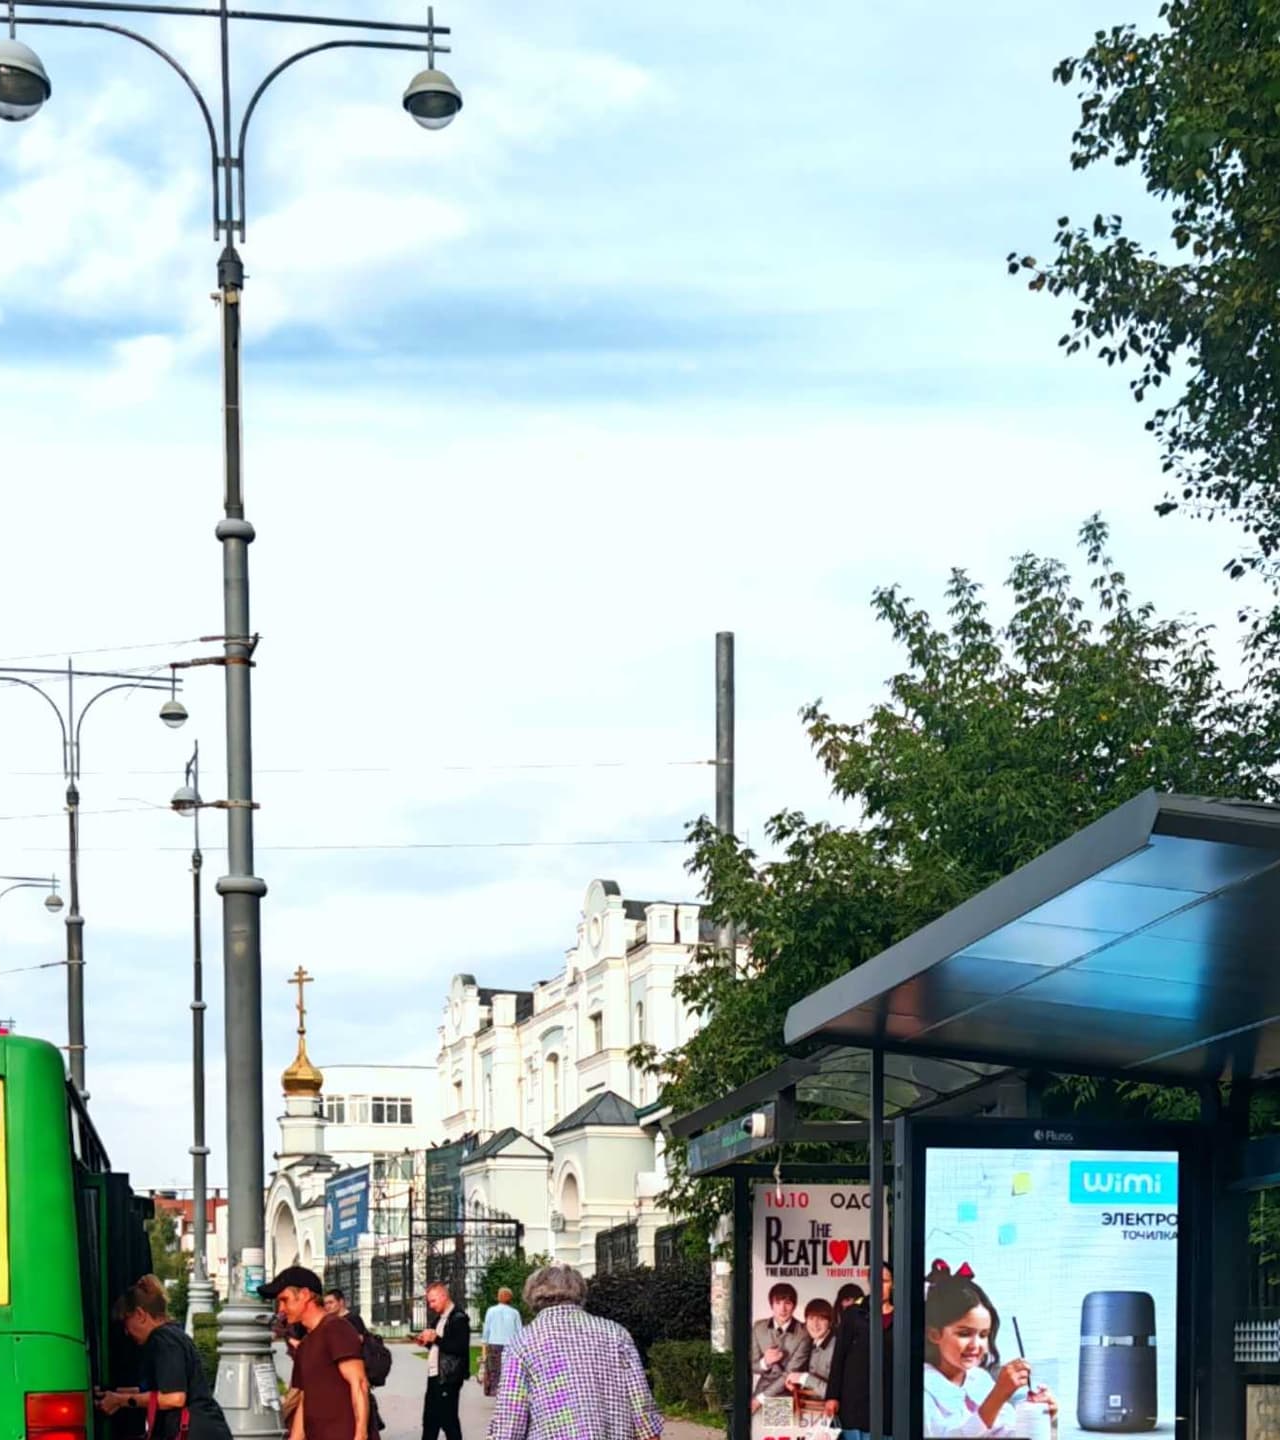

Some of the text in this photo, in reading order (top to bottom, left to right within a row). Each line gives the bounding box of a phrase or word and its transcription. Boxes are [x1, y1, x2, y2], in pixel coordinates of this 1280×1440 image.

[1082, 1172, 1162, 1194] wimi
[765, 1192, 809, 1209] 10.10
[1101, 1212, 1178, 1226] ЭЛЕКТРО
[1121, 1230, 1178, 1241] ТОЧИЛКА
